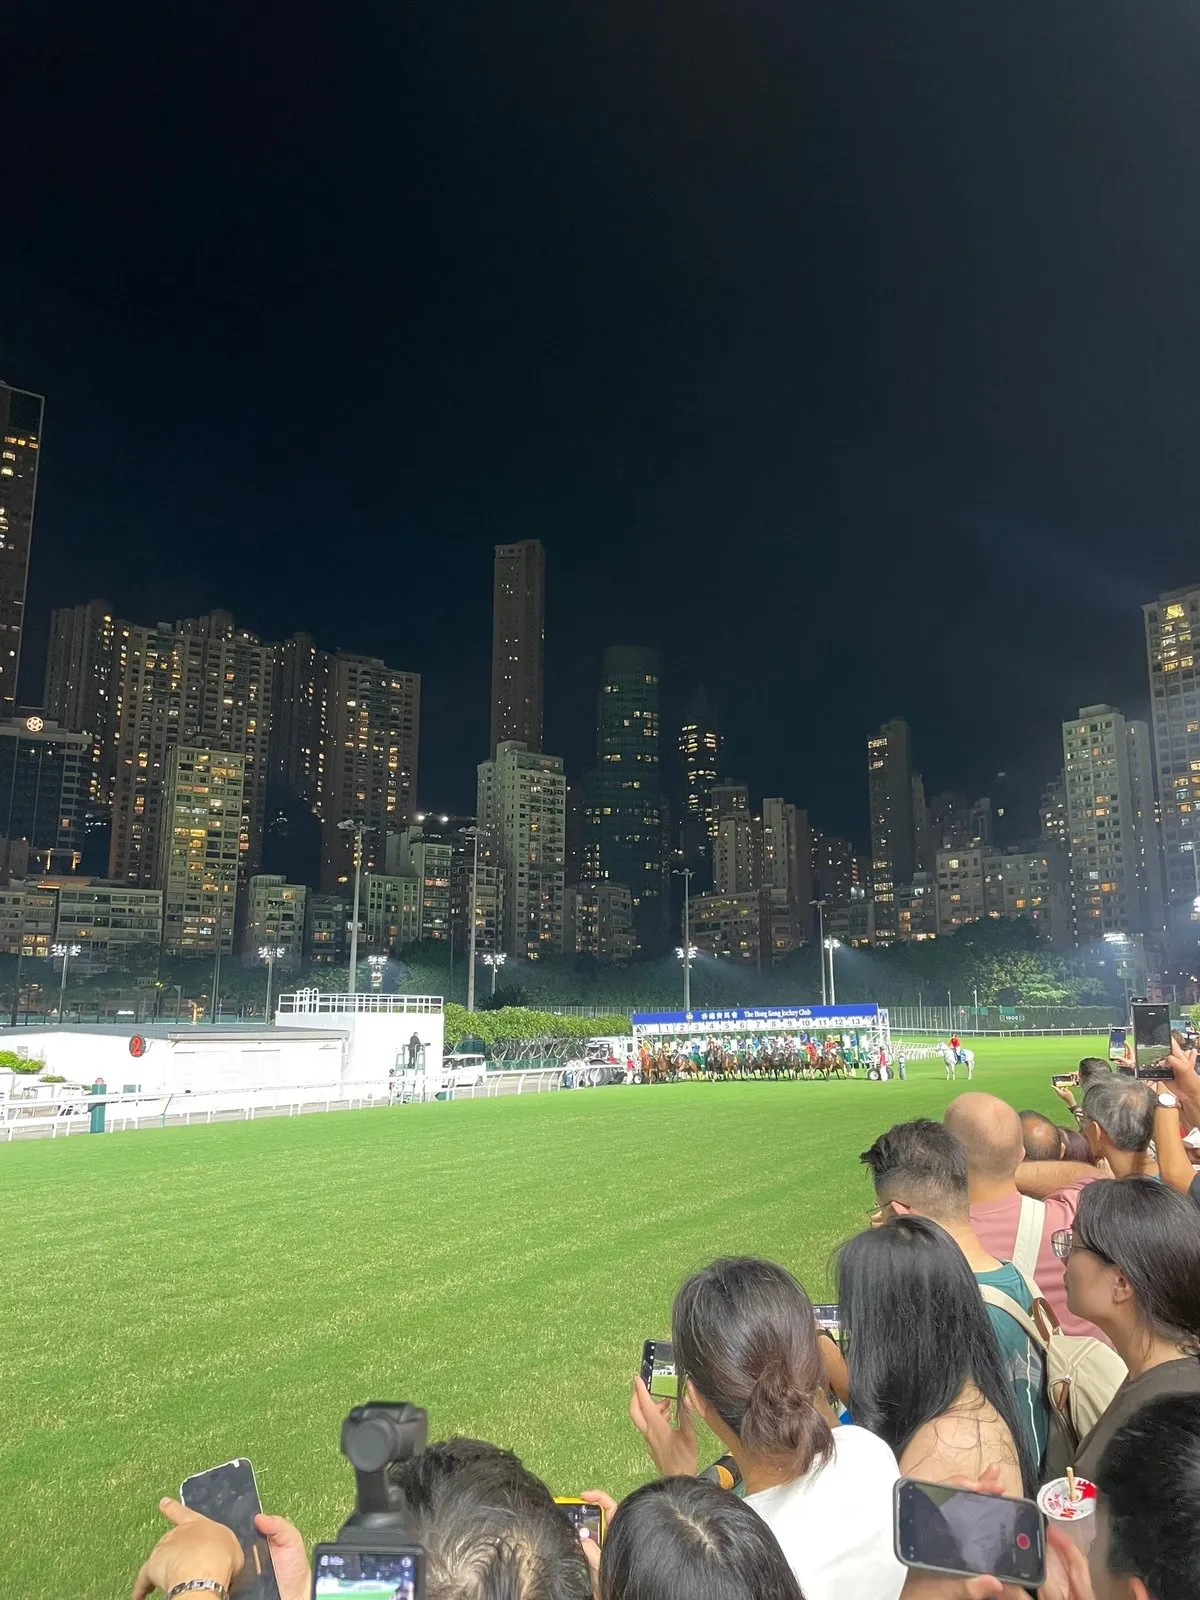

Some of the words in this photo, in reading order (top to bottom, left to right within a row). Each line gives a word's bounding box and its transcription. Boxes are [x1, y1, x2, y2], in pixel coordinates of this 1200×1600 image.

[768, 1010, 781, 1018] Kong
[782, 1009, 798, 1018] Jockey
[132, 1036, 141, 1056] 2
